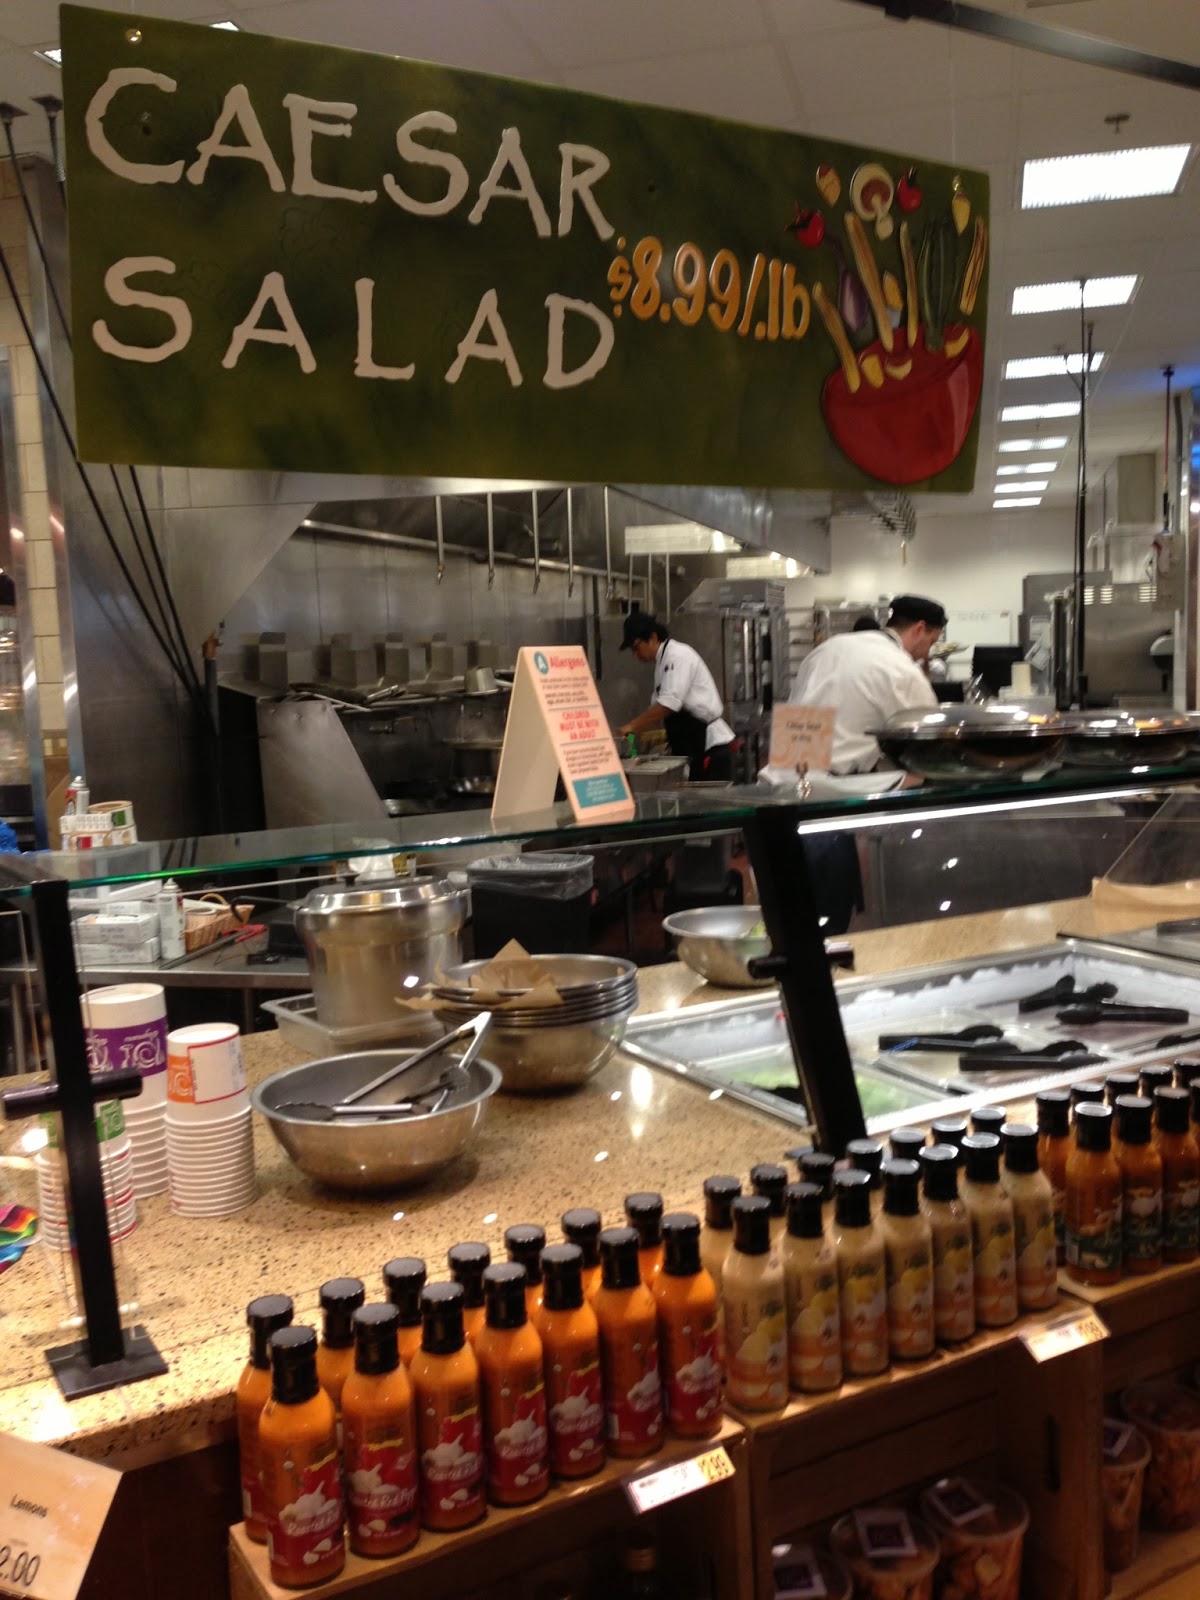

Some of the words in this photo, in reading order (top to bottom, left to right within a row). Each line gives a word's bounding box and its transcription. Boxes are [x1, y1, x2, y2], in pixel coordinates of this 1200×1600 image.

[86, 67, 615, 240] CAESAR
[92, 256, 615, 389] SALAD
[10, 1493, 49, 1519] Lemons
